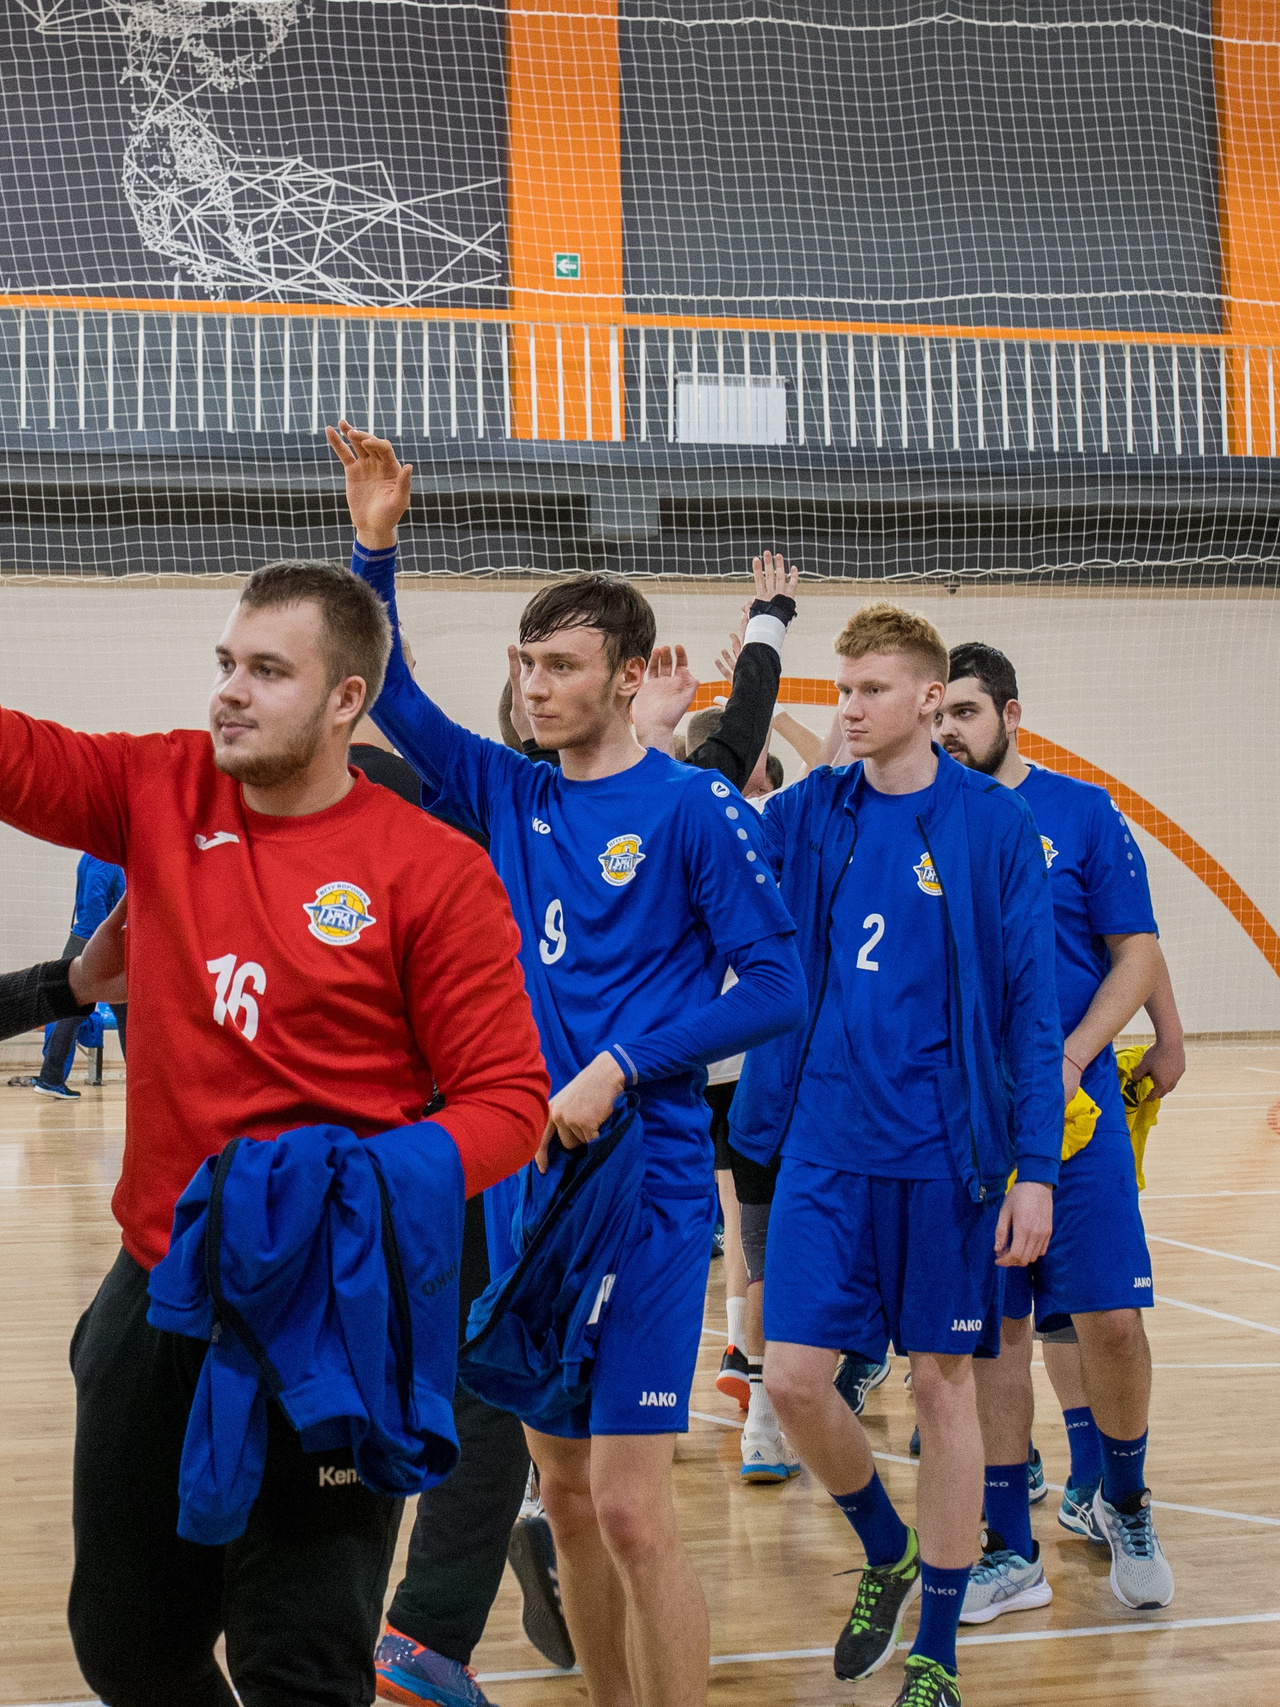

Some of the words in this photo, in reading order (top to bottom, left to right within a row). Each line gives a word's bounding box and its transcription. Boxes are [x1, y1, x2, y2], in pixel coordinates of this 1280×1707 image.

[532, 816, 551, 834] KO
[539, 899, 567, 965] 9
[856, 913, 885, 971] 2
[206, 953, 267, 1042] 16
[1133, 1276, 1151, 1288] JAKO
[951, 1319, 982, 1331] JAKO
[639, 1391, 677, 1407] JAKO
